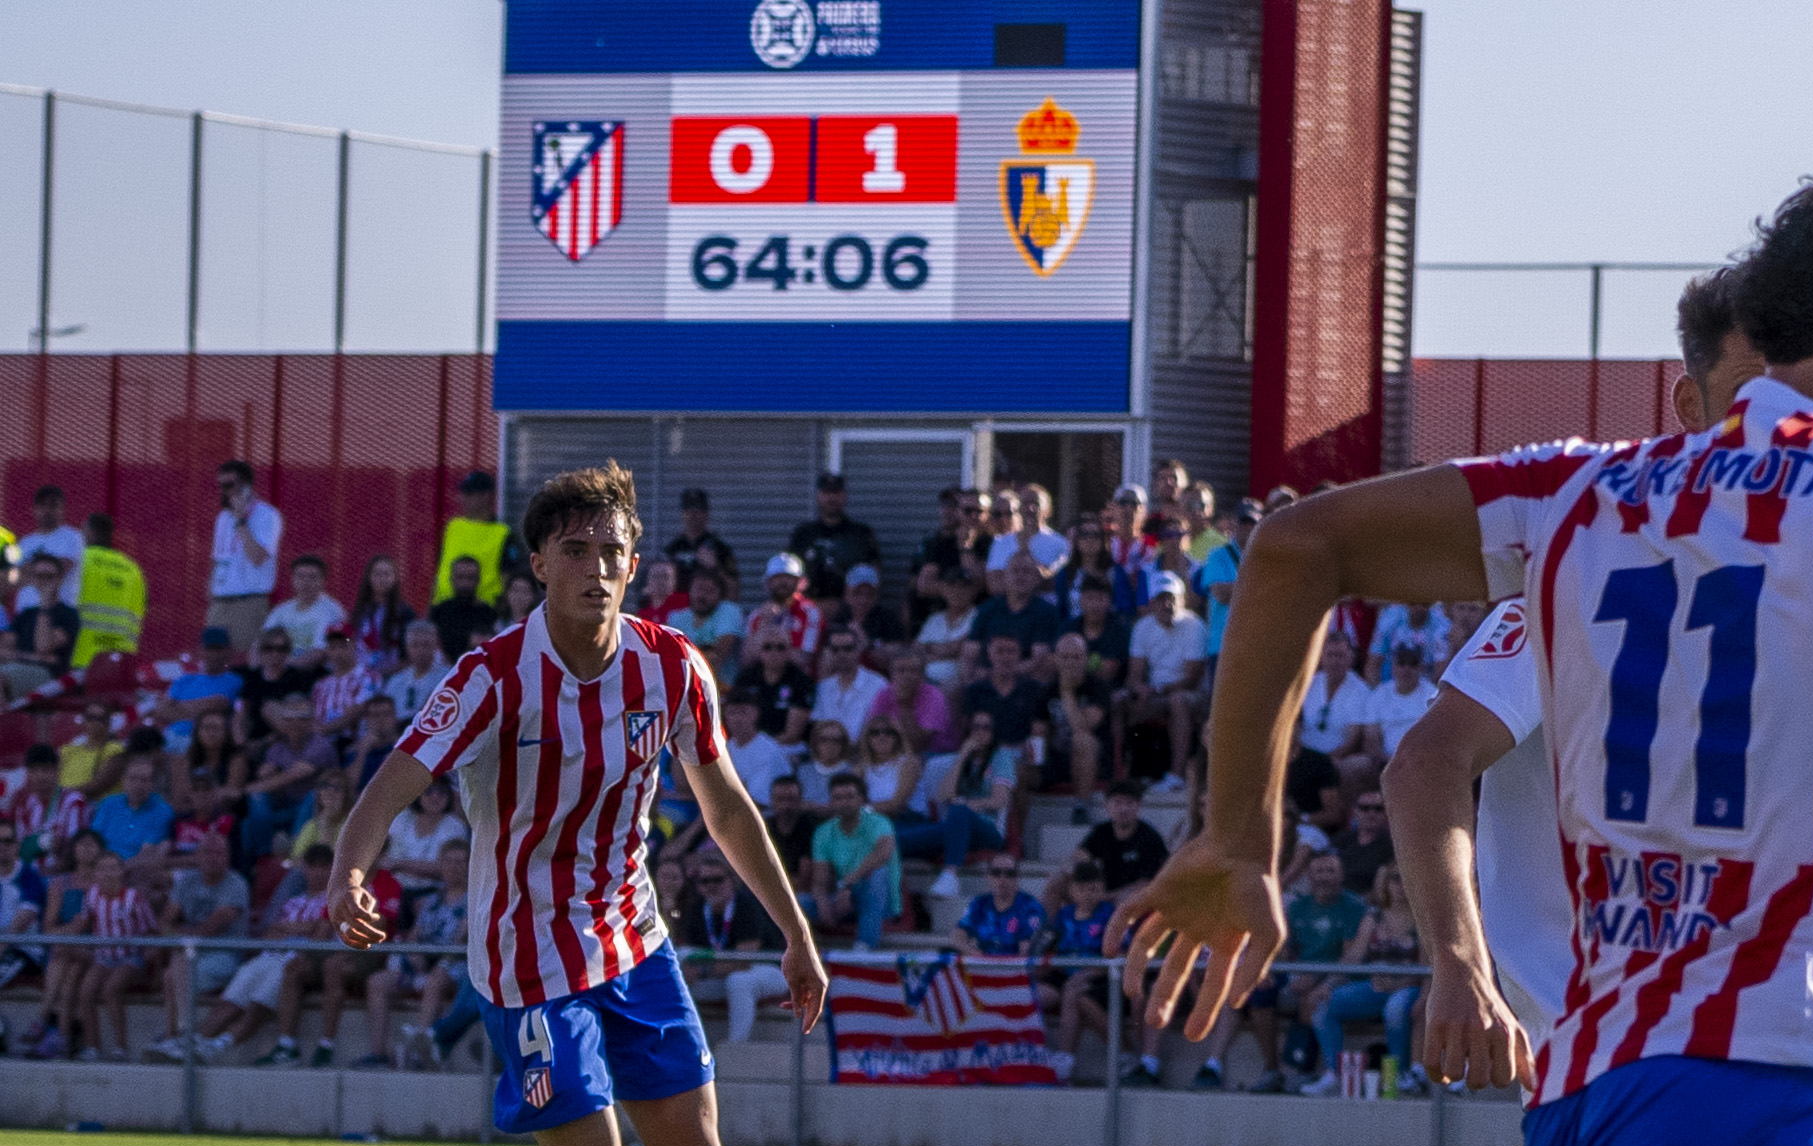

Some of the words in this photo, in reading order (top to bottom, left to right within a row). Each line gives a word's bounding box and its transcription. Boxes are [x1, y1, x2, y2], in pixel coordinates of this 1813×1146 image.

[709, 124, 774, 194] 0
[862, 123, 906, 193] 1
[693, 234, 931, 291] 64:06
[1592, 557, 1767, 830] 11
[1604, 855, 1720, 906] VISIT
[518, 1007, 551, 1063] 4
